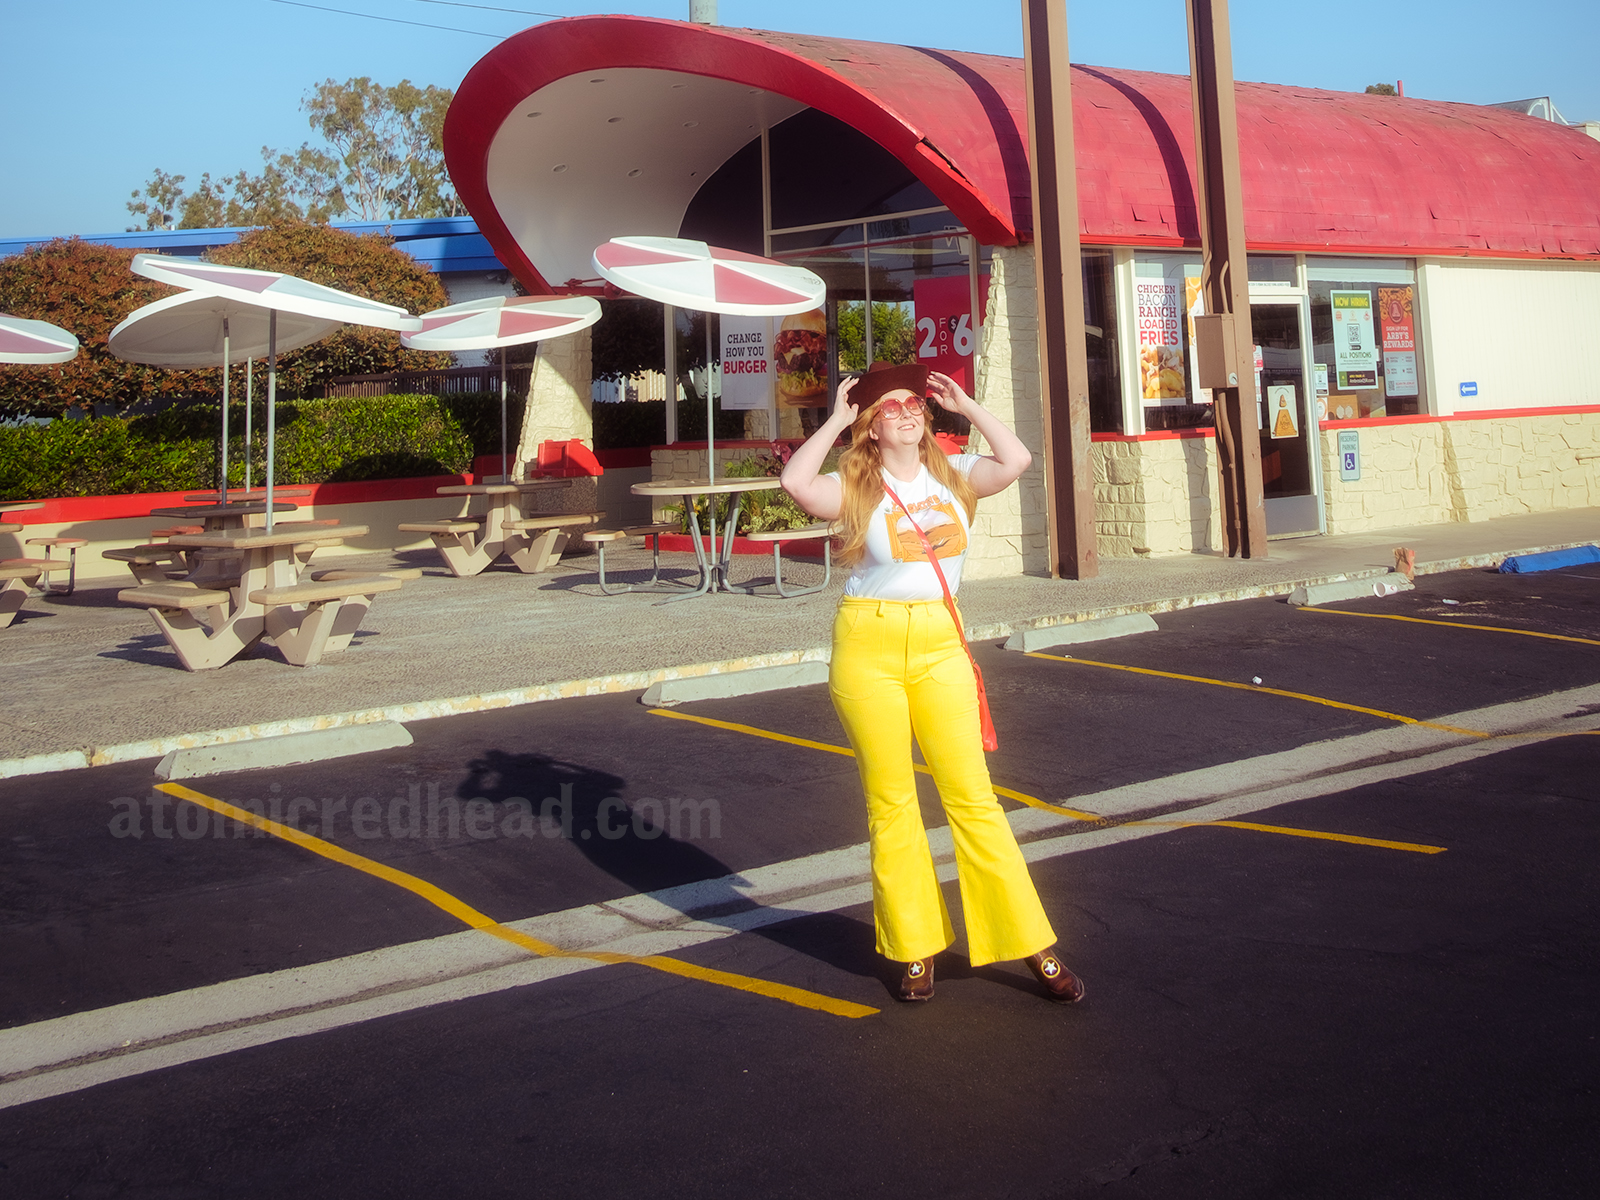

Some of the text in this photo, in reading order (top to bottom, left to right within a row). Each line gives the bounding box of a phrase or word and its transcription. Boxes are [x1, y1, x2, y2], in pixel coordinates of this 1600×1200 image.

[1137, 284, 1175, 294] CHICKEN
[1138, 294, 1176, 306] BACON
[1335, 297, 1368, 307] NOW HIRING
[1139, 306, 1177, 318] RANCH
[1139, 319, 1178, 330] LOADED
[727, 333, 762, 344] CHANGE
[917, 317, 938, 358] 2
[940, 317, 948, 355] FOR
[1140, 331, 1179, 346] FRIES
[1384, 340, 1413, 348] REWARDS
[725, 346, 764, 357] HOW YOU
[1349, 351, 1372, 359] POSITIONS
[723, 360, 767, 374] BURGER
